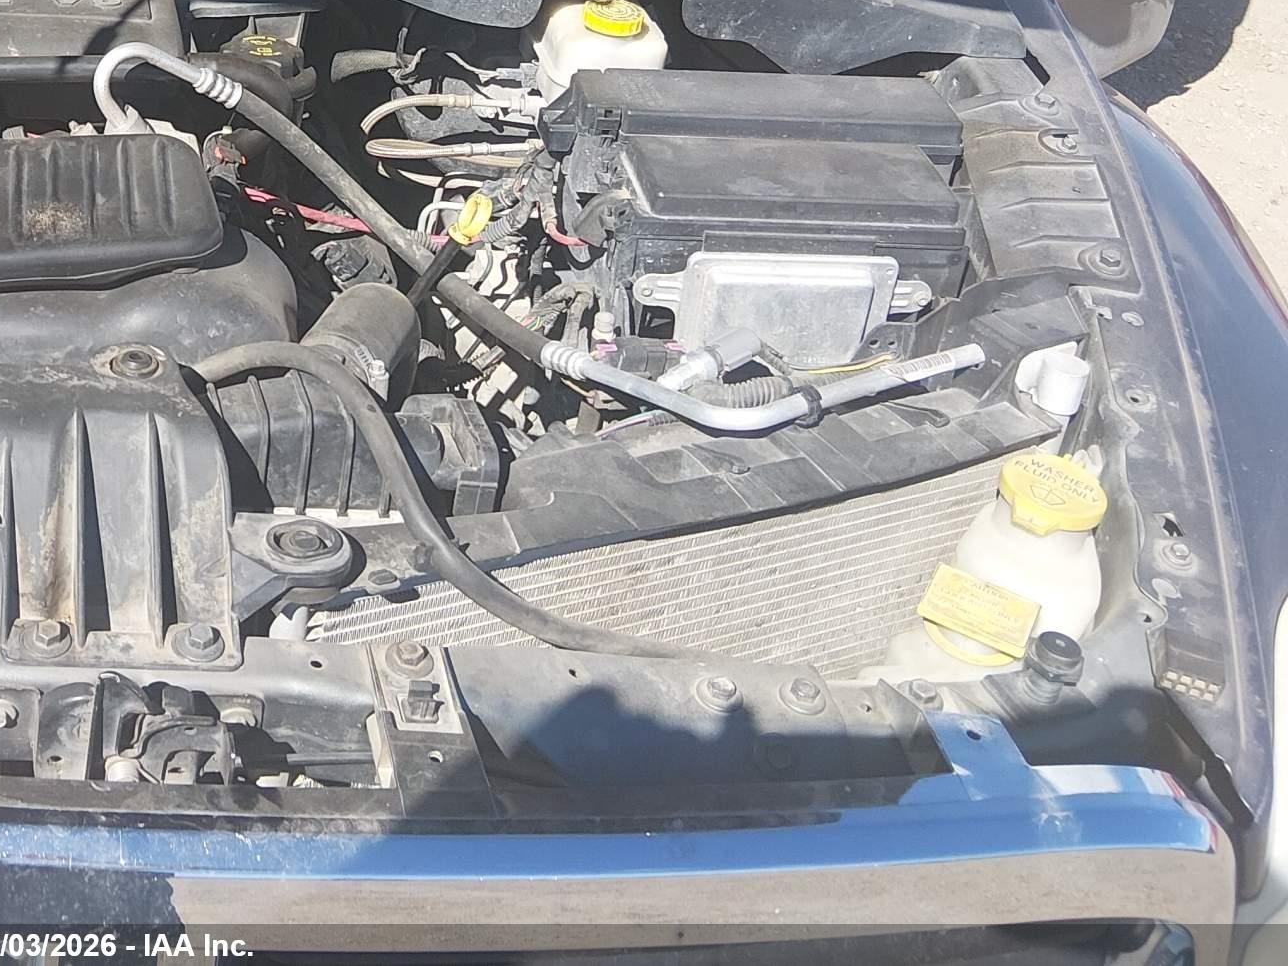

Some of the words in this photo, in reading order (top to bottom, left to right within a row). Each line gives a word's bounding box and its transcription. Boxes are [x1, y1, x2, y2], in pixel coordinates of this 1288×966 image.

[1013, 460, 1058, 483] FLUID
[1061, 482, 1100, 503] ONLY
[1031, 458, 1095, 493] WASHER
